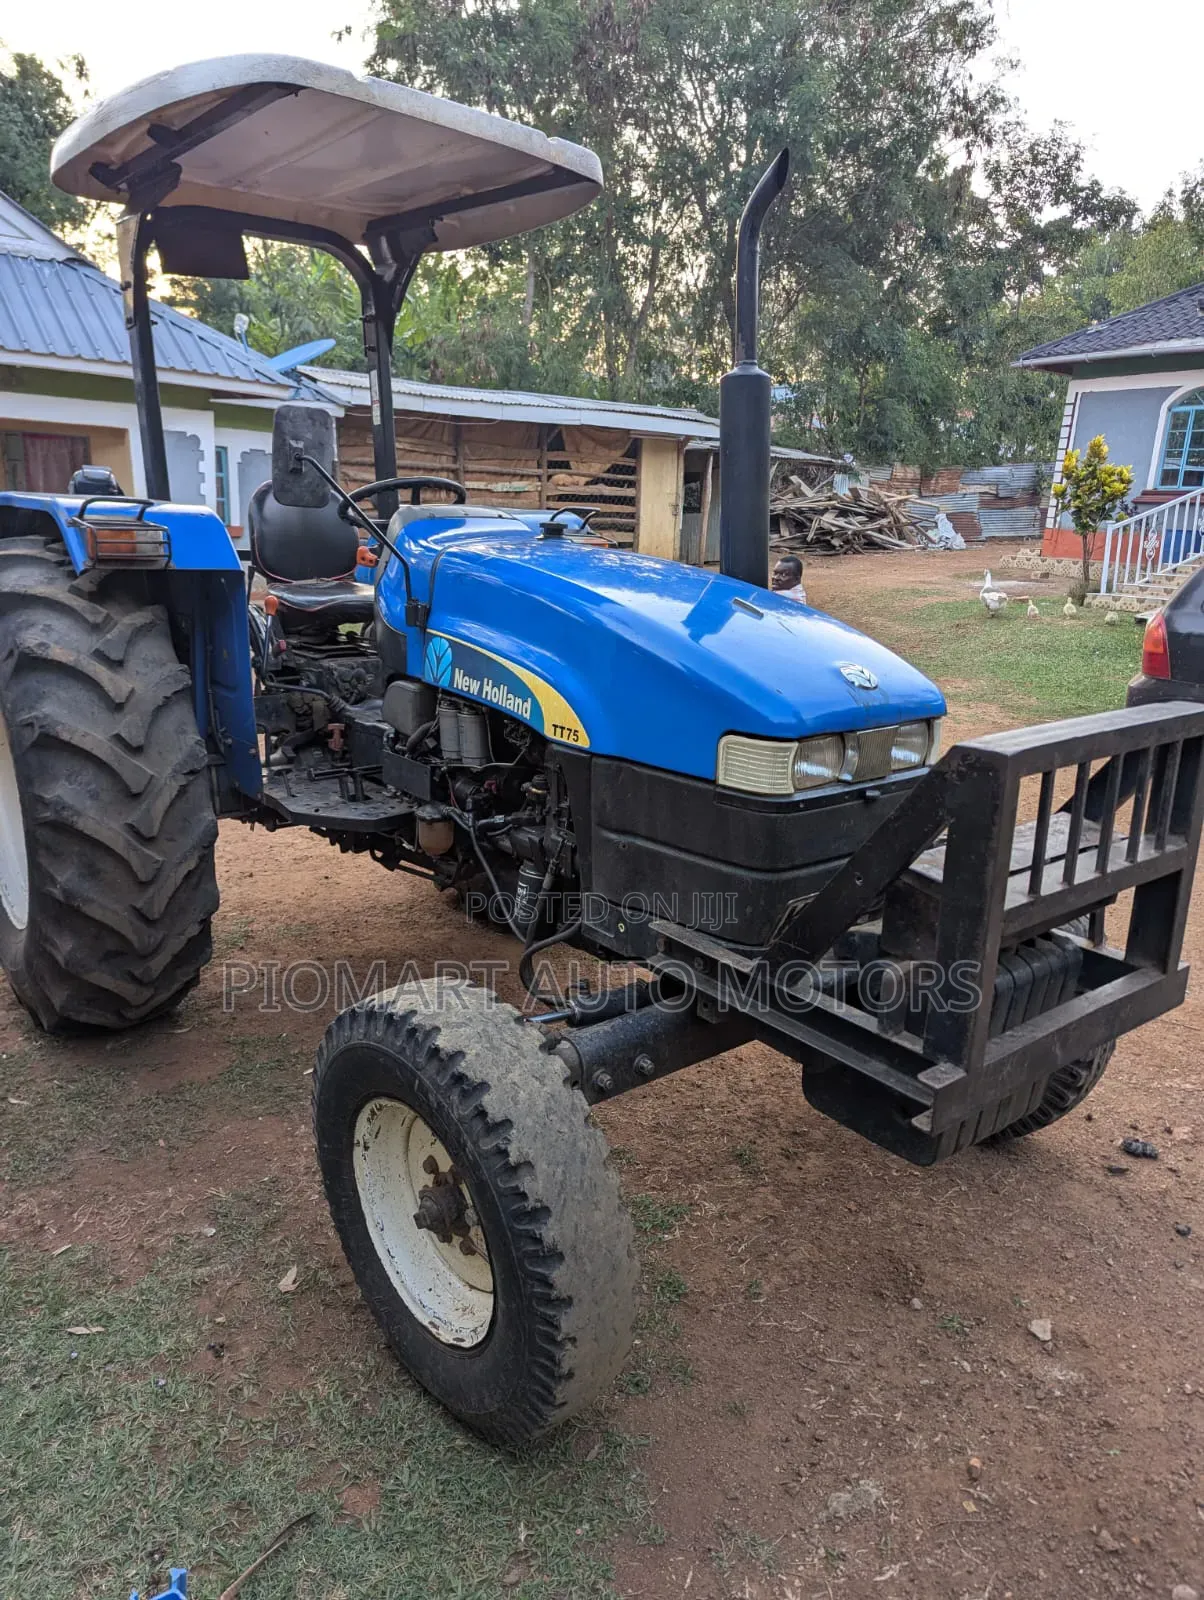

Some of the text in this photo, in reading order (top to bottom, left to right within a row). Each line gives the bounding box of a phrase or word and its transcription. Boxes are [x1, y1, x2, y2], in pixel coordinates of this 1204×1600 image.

[453, 668, 531, 720] New Holland
[552, 723, 579, 742] TT75
